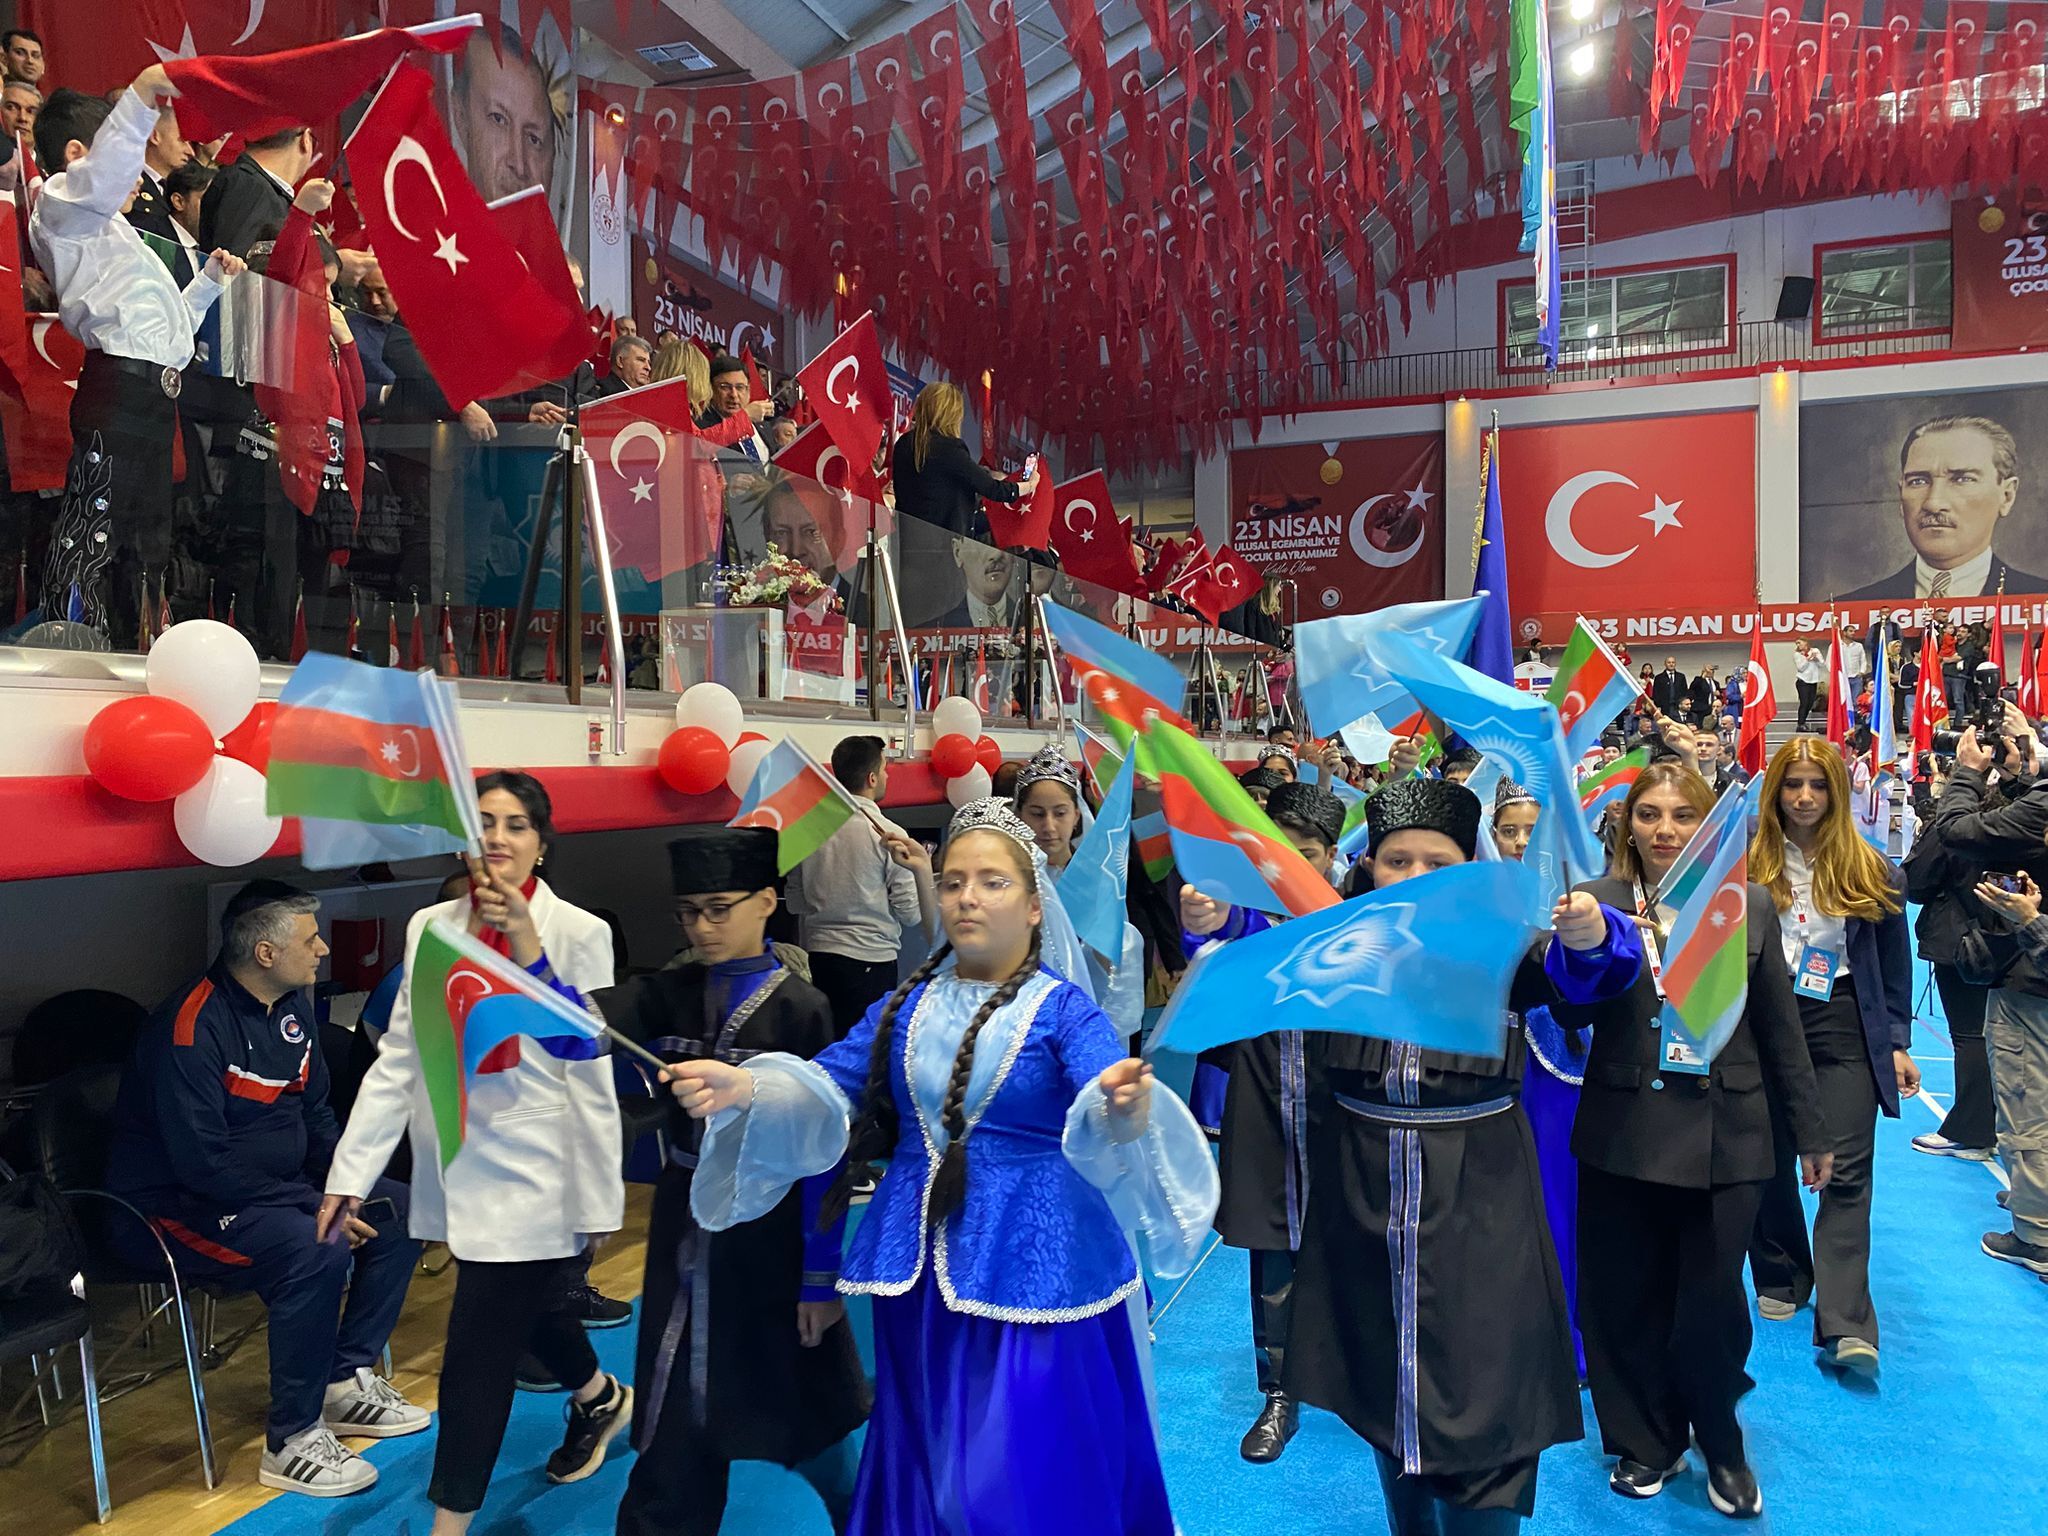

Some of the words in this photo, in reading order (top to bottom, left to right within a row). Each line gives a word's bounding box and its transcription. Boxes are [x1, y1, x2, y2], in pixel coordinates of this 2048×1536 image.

[2003, 235, 2047, 265] 23
[654, 295, 674, 326] 23
[678, 306, 726, 346] NİSAN
[1235, 520, 1262, 541] 23
[1268, 514, 1342, 539] NİSAN
[1234, 541, 1270, 552] ULUSAL
[1271, 536, 1325, 550] EGEMENLİK
[1327, 536, 1340, 546] VE
[1274, 548, 1338, 561] BAYRAMIMIZ
[1626, 615, 1723, 637] NİSAN
[1732, 610, 1859, 634] ULUSAL
